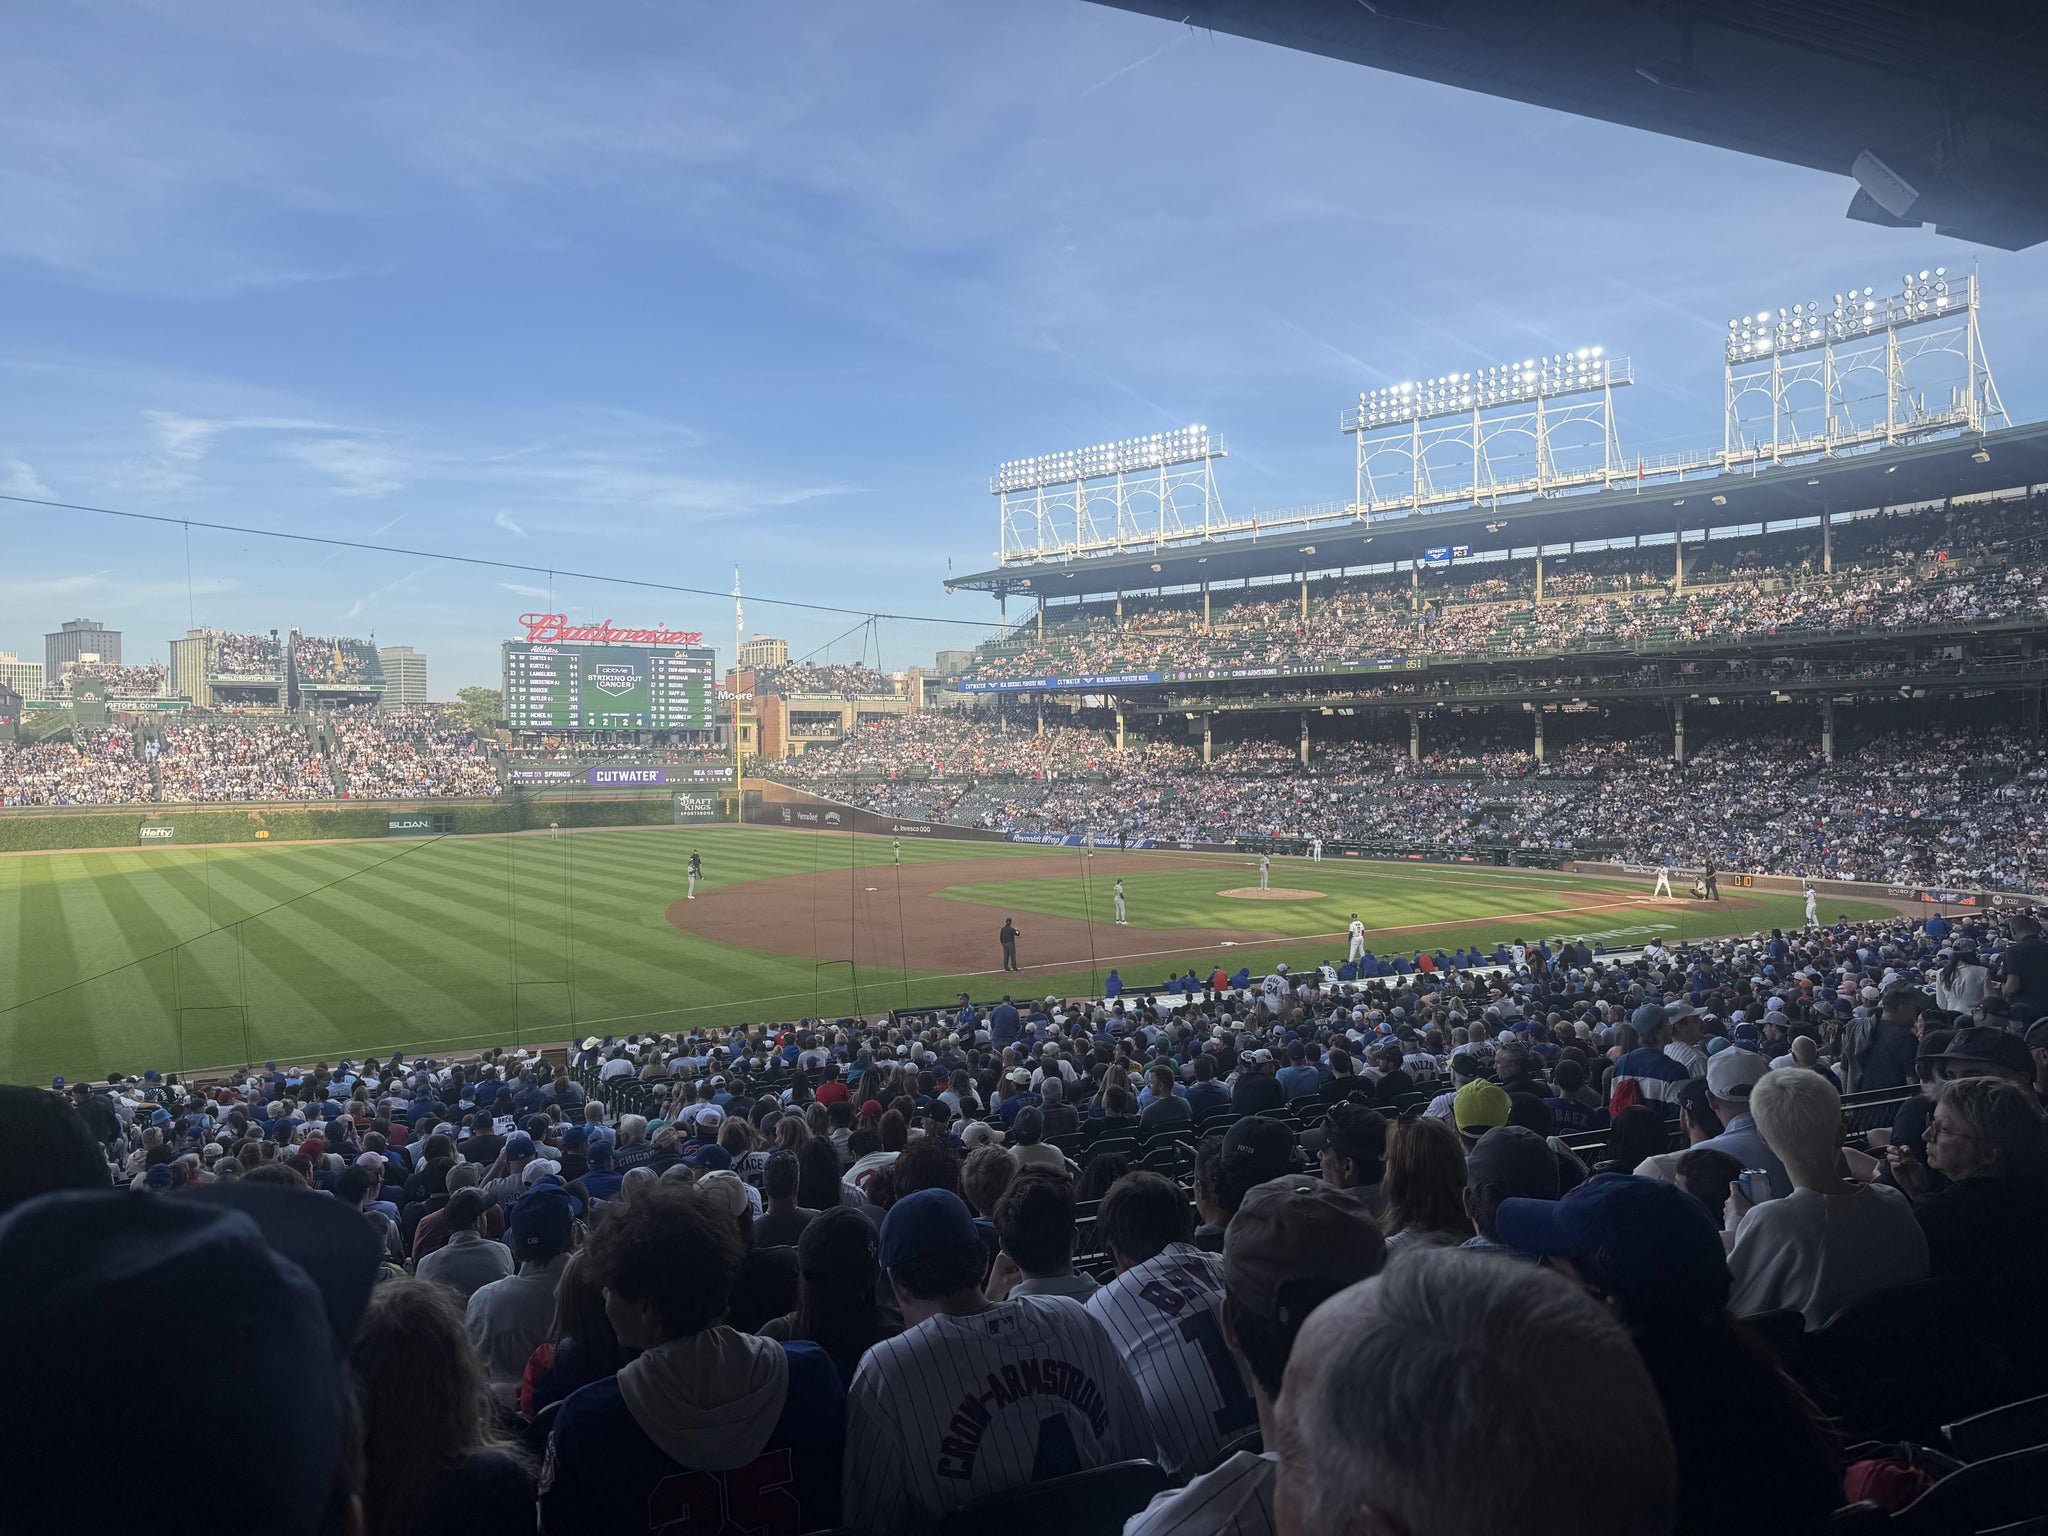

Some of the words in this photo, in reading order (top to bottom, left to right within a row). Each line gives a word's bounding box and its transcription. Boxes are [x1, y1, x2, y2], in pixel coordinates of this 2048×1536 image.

[518, 613, 703, 645] Budweiser
[530, 645, 560, 654] Athletics
[1406, 660, 1416, 668] 85
[1232, 668, 1277, 677] CROW-ARMSTRONG
[597, 771, 657, 781] CUTWATER
[142, 829, 171, 837] Hefty
[1013, 834, 1040, 844] Reynolds
[1042, 836, 1060, 846] Wrap
[1266, 984, 1278, 996] 34
[1410, 1060, 1433, 1072] RIZZO
